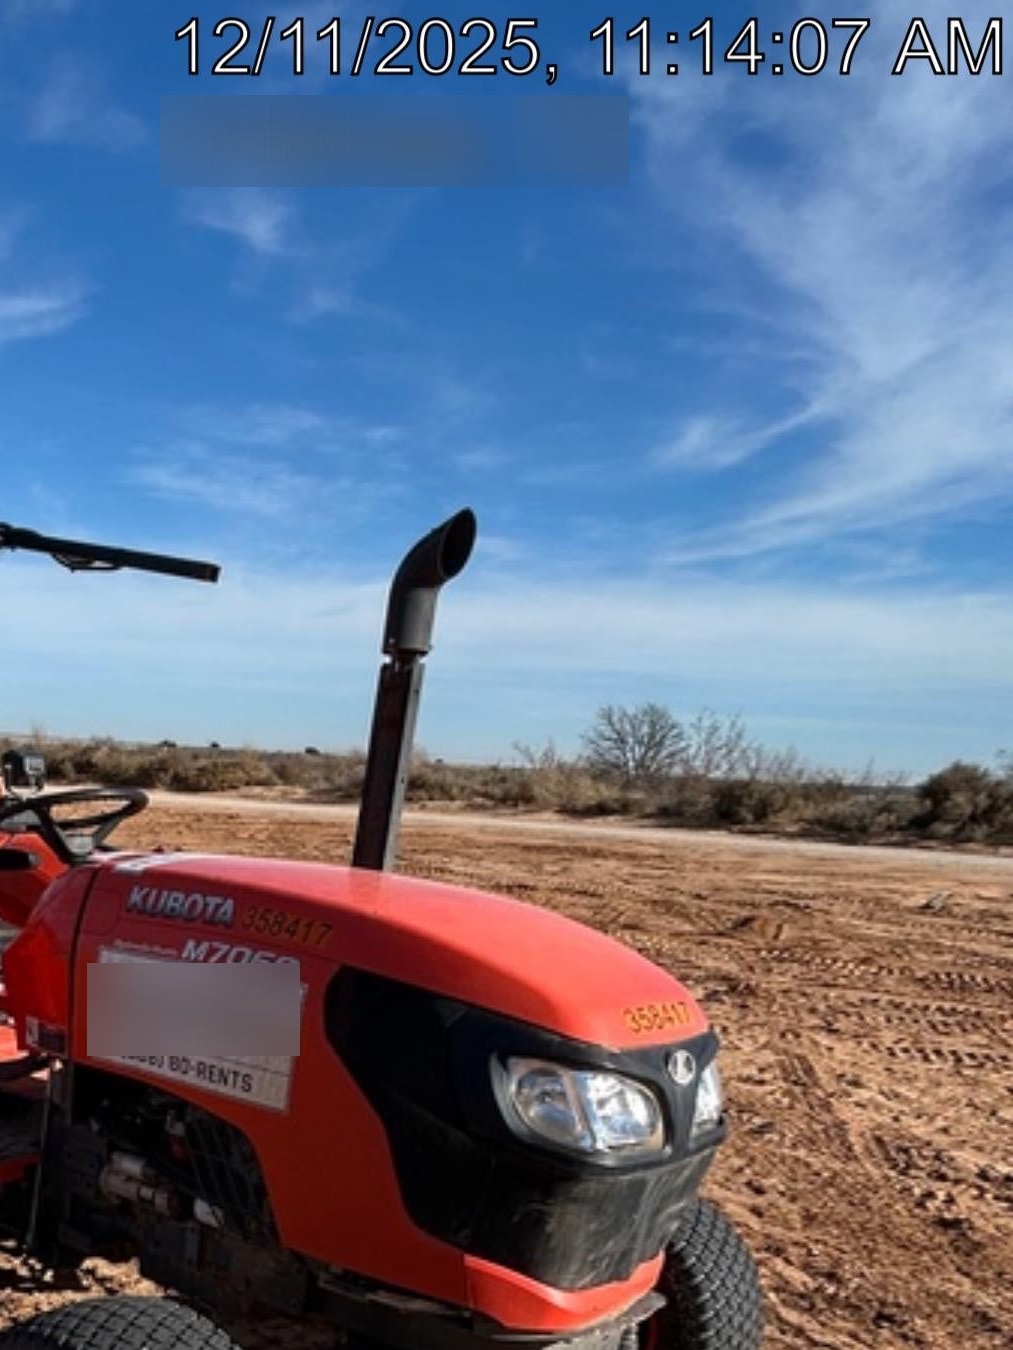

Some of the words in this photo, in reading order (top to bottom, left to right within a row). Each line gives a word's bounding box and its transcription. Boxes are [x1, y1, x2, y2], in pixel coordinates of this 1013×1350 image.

[127, 886, 235, 925] KUBOTA
[242, 905, 332, 946] 358417
[623, 1001, 690, 1034] 358417
